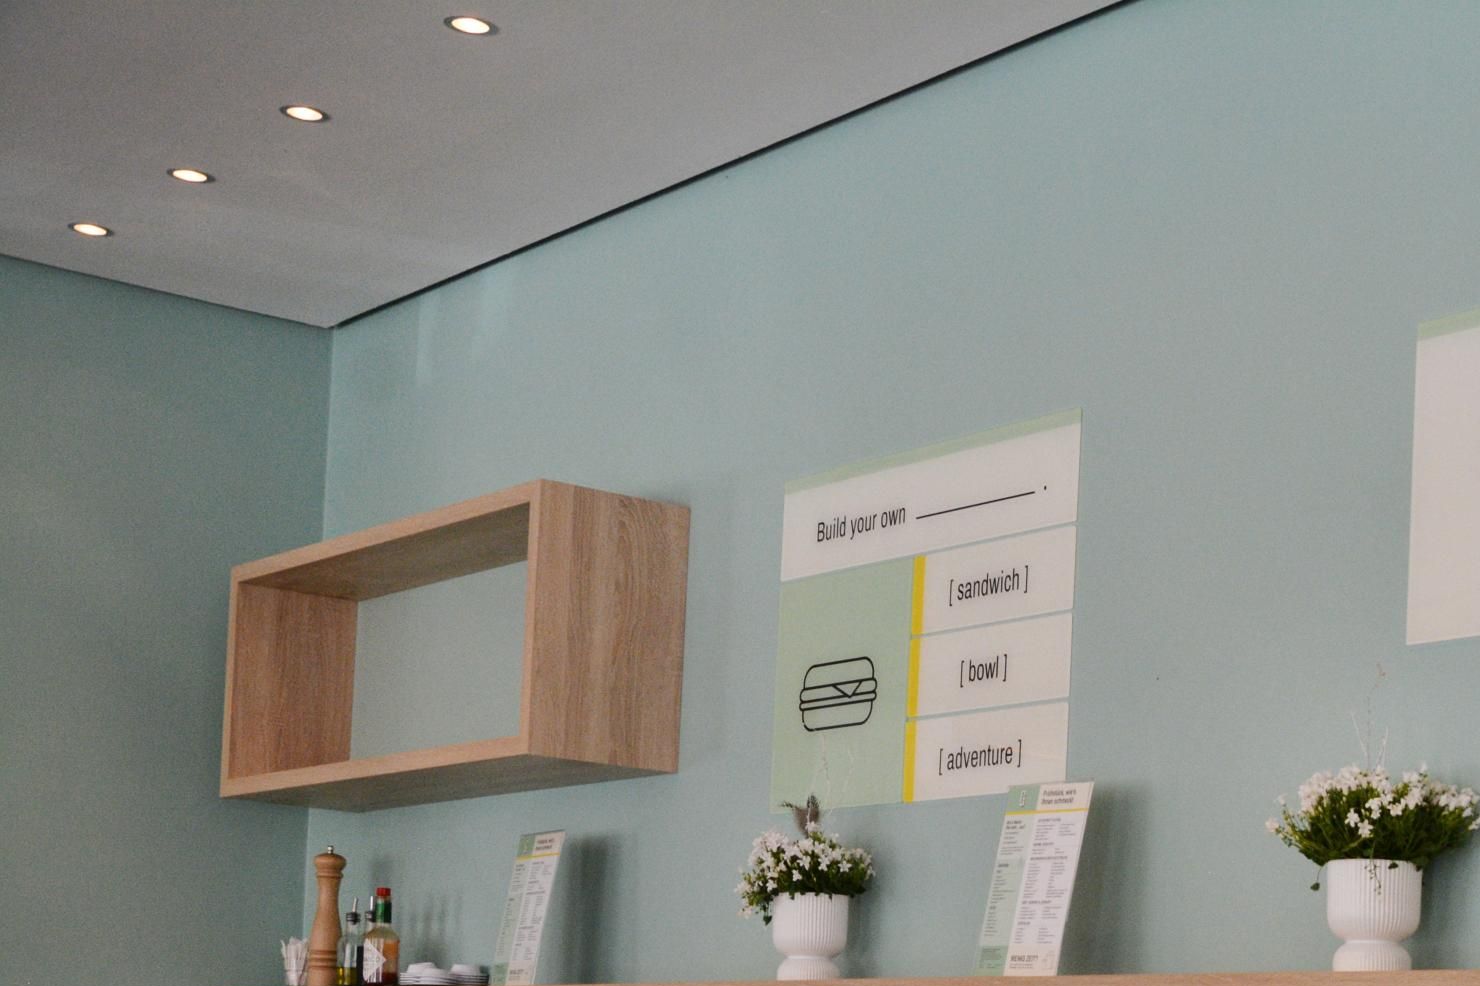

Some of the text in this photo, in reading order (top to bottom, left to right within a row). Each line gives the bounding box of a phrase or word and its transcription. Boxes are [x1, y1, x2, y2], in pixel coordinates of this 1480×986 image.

[816, 507, 906, 543] Build your own
